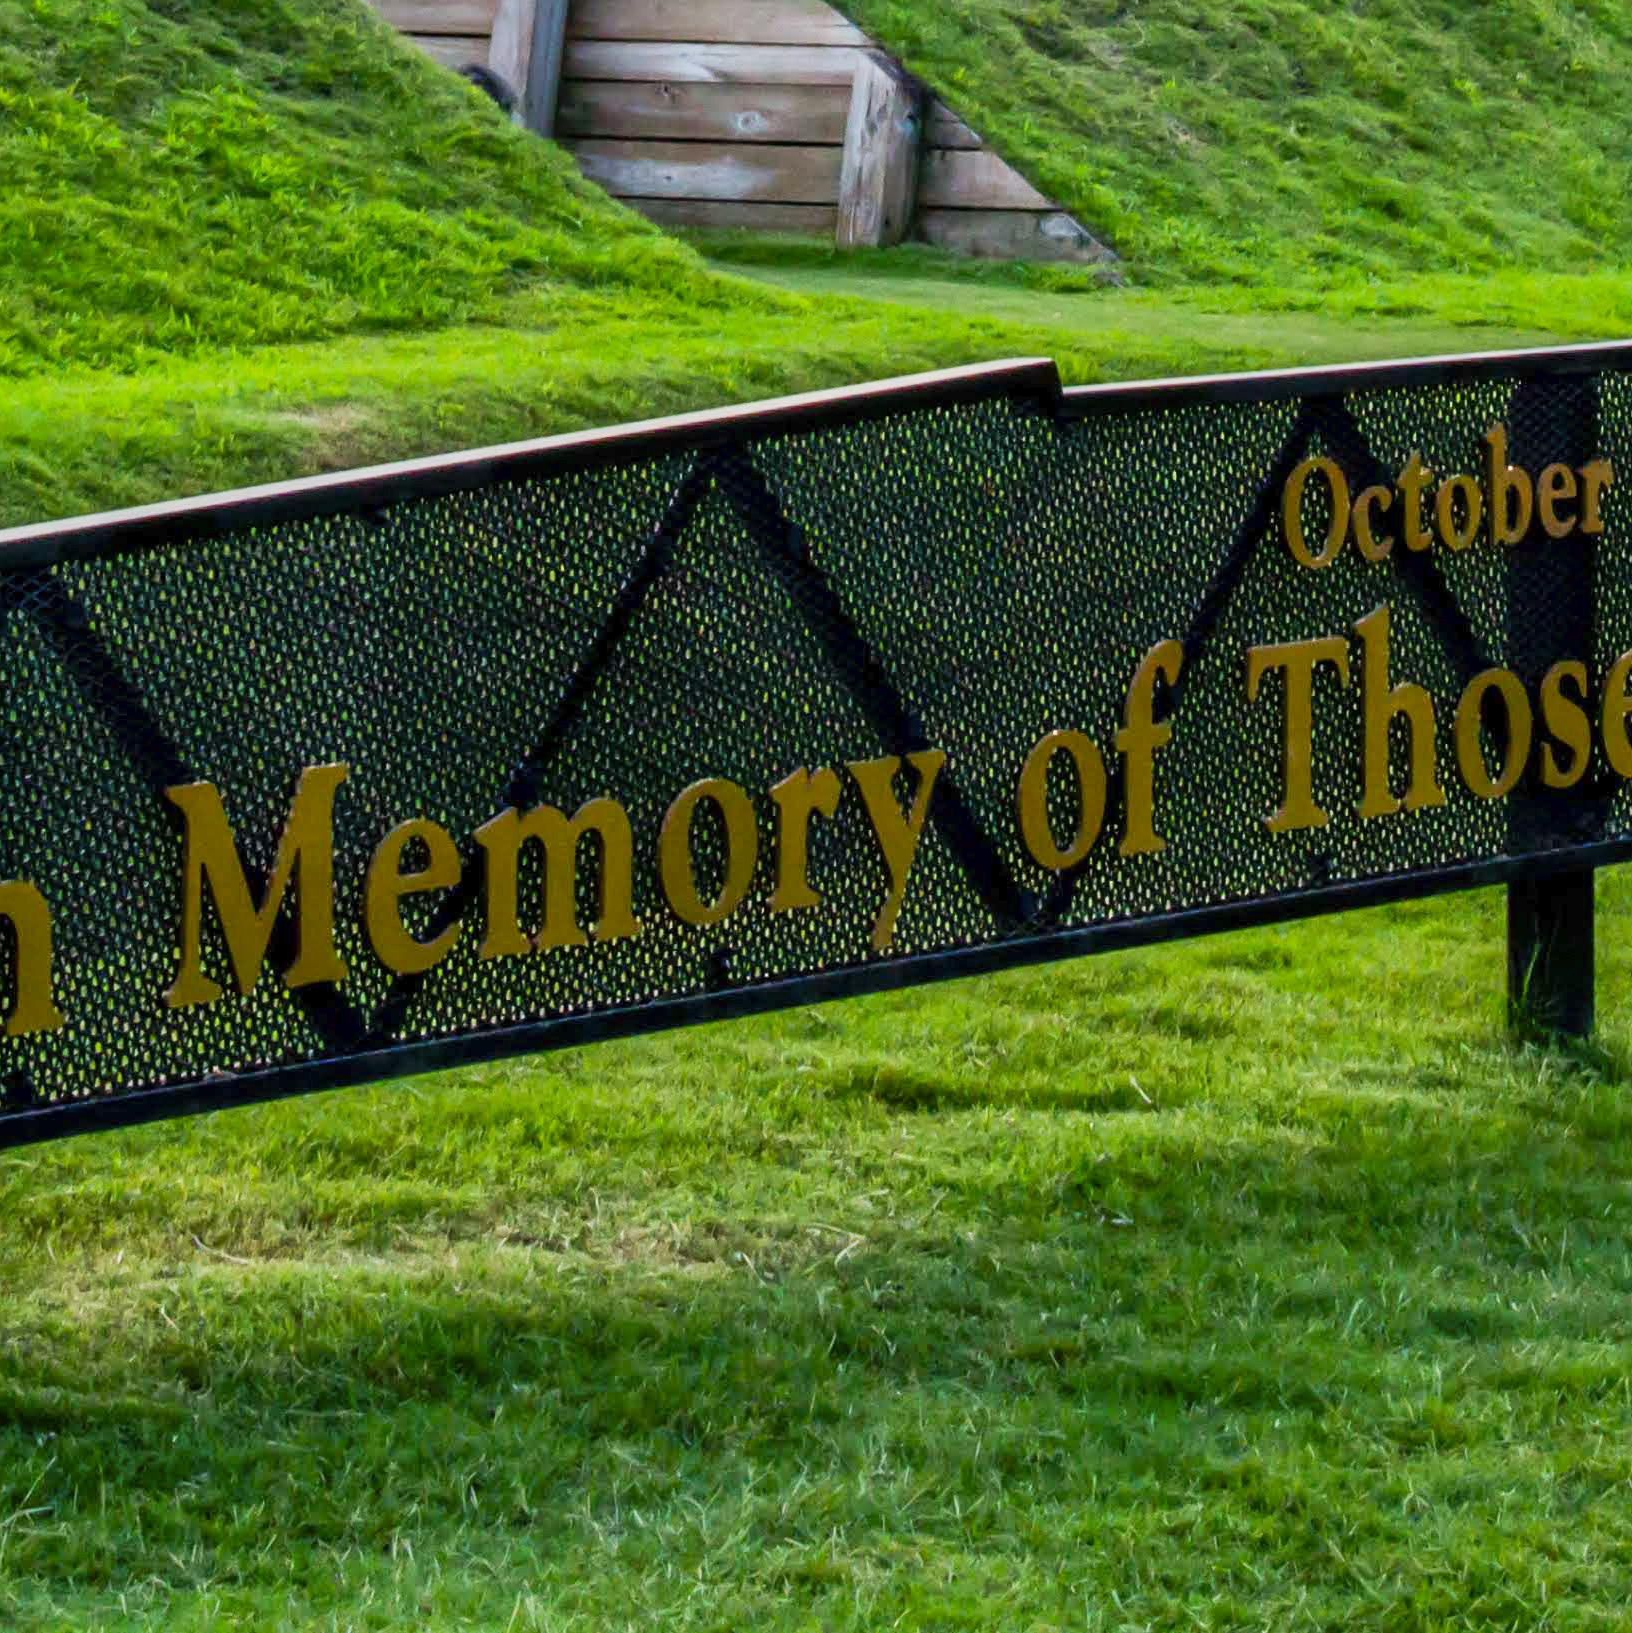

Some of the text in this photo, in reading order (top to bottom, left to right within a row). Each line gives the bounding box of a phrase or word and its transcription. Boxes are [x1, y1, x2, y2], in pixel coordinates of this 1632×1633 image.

[1282, 422, 1613, 569] October
[166, 749, 946, 1008] Memory
[1016, 638, 1184, 871] of
